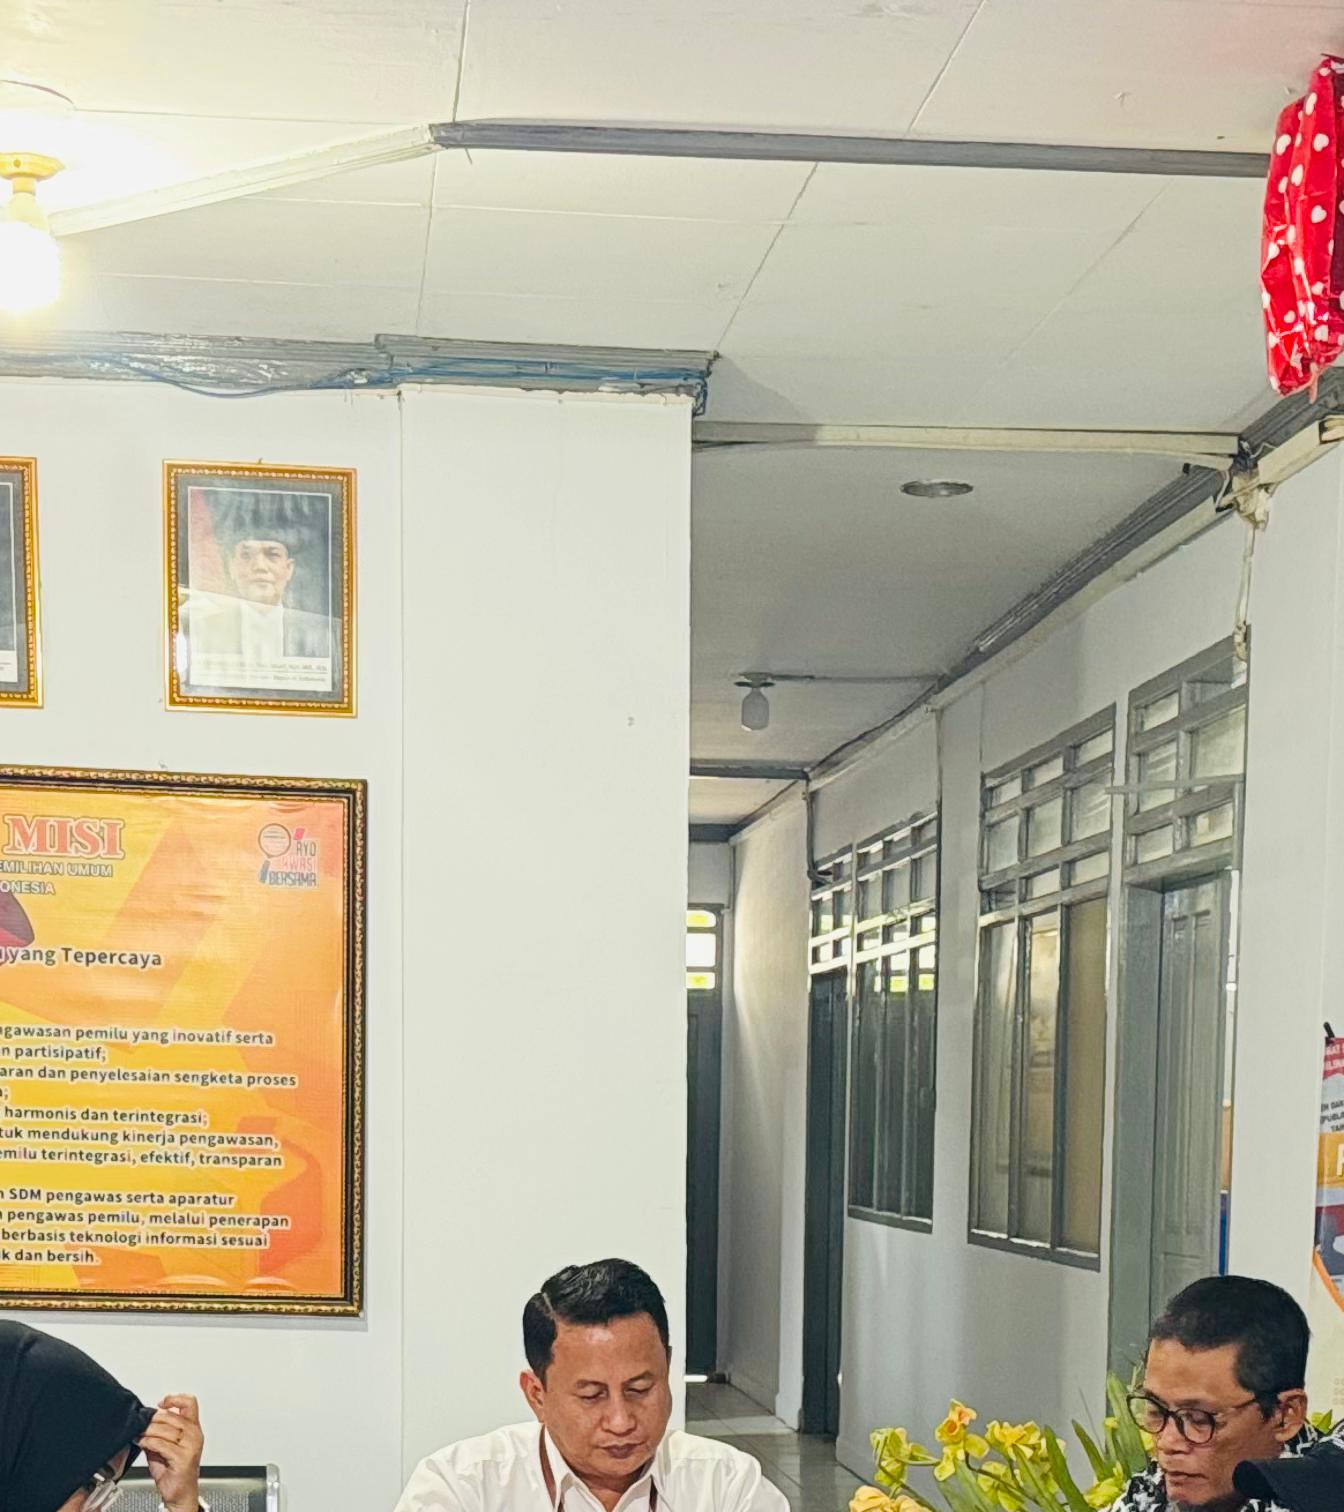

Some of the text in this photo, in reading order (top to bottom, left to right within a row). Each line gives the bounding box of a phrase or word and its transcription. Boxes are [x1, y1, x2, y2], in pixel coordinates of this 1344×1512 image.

[7, 815, 125, 859] MISI
[68, 863, 113, 877] UMUM
[7, 949, 56, 966] yang
[61, 947, 162, 968] Tepercaya
[76, 1025, 127, 1042] pemilu
[133, 1030, 168, 1043] yang
[173, 1028, 231, 1042] inovatif
[236, 1030, 272, 1043] serta
[38, 1065, 65, 1078] dan
[70, 1066, 169, 1084] penyelesaian
[174, 1069, 242, 1087] sengketa
[247, 1074, 296, 1088] proses
[4, 1105, 76, 1119] harmonis
[80, 1107, 108, 1120] dan
[27, 1126, 118, 1144] mendukung
[122, 1129, 174, 1146] kinerja
[199, 1151, 281, 1169] transparan
[9, 1187, 41, 1201] SDM
[46, 1191, 122, 1206] pengawas
[126, 1190, 164, 1204] serta
[169, 1191, 234, 1208] aparatur
[7, 1211, 83, 1225] pengawas
[149, 1211, 204, 1225] melalui
[209, 1215, 289, 1230] penerapan
[1, 1228, 65, 1242] berbasis
[69, 1229, 141, 1246] teknologi
[145, 1231, 216, 1245] informasi
[221, 1233, 268, 1246] sesuai
[14, 1248, 42, 1261] dan
